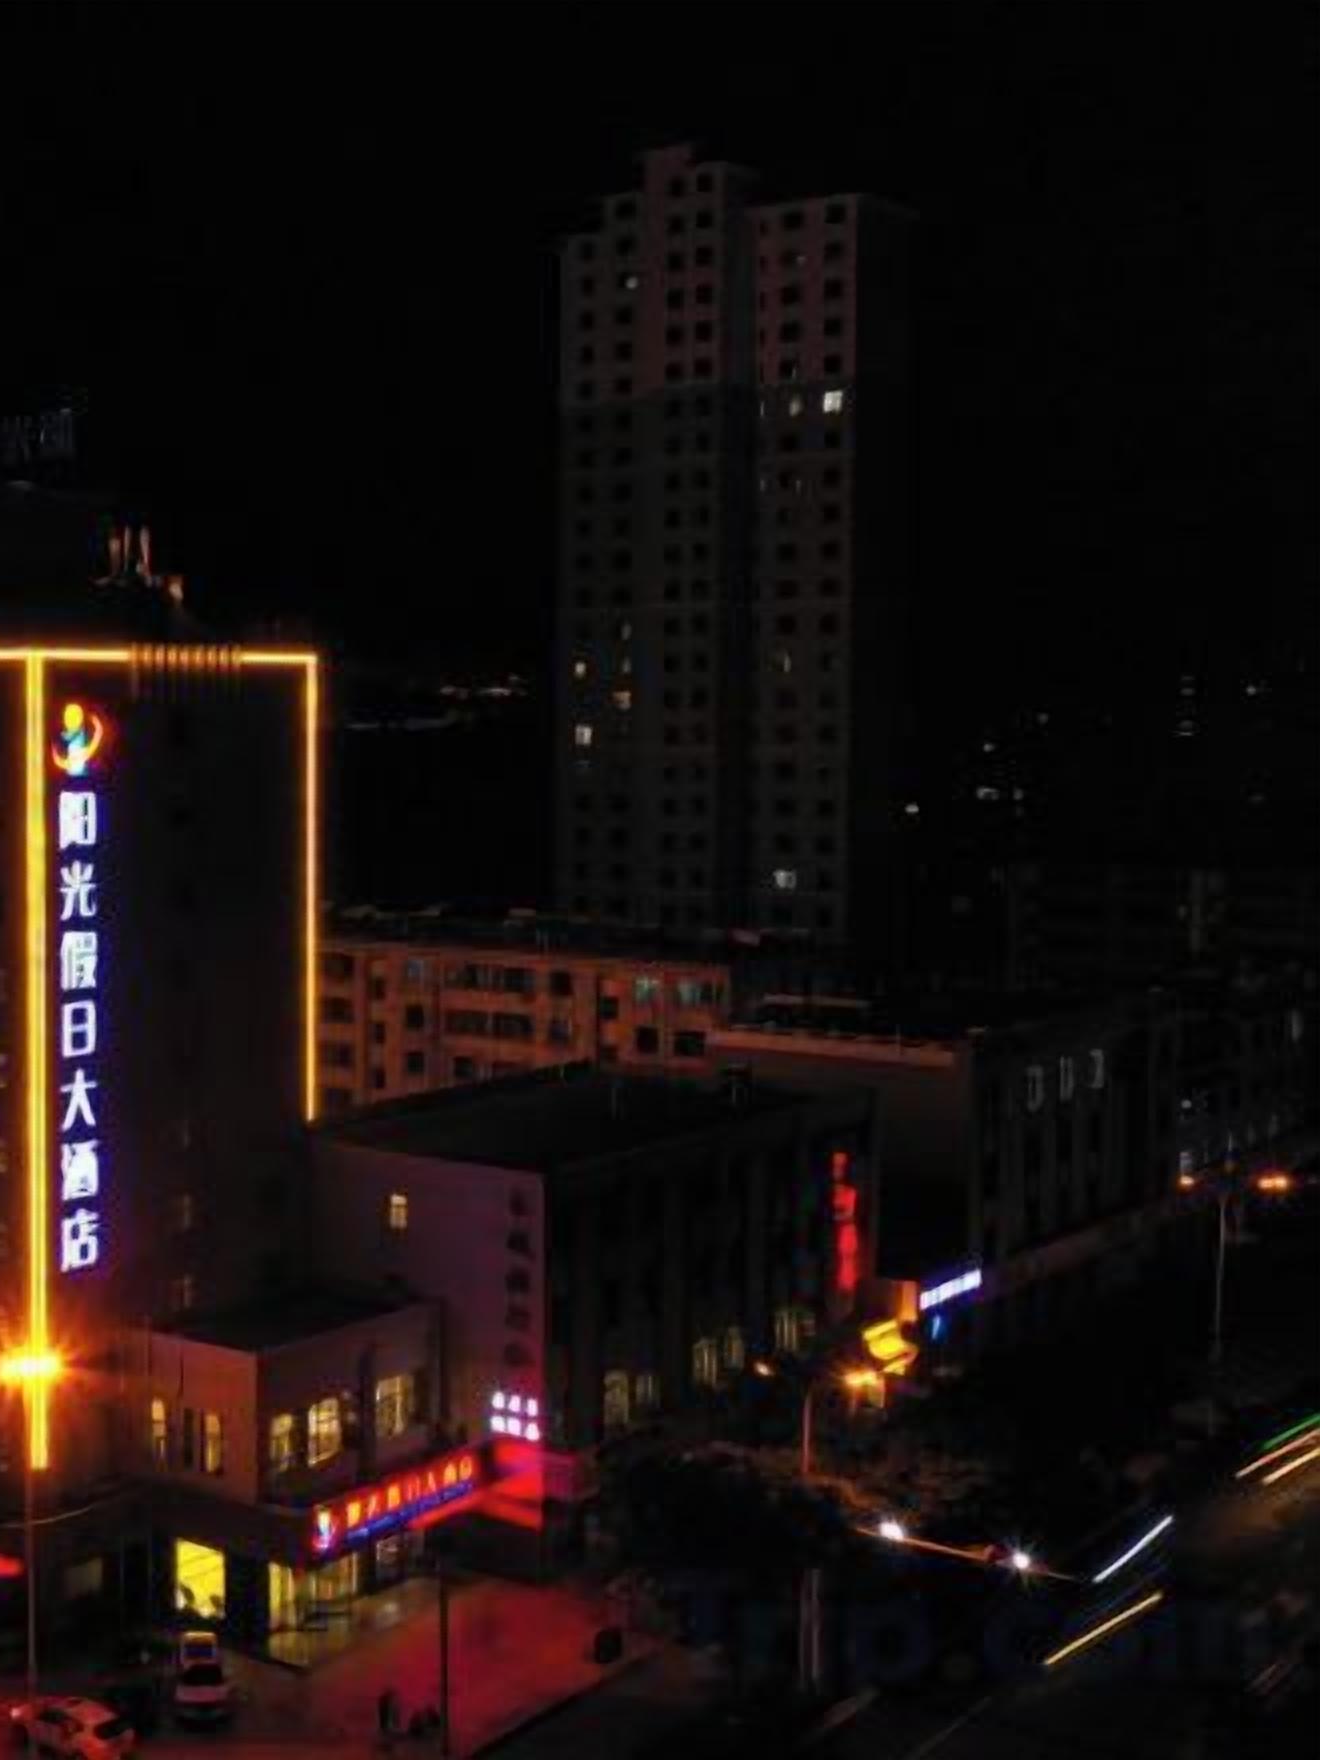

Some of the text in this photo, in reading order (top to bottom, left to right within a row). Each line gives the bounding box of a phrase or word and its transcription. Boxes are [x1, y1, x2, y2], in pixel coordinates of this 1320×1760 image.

[58, 791, 99, 1272] 阳光假日大酒店
